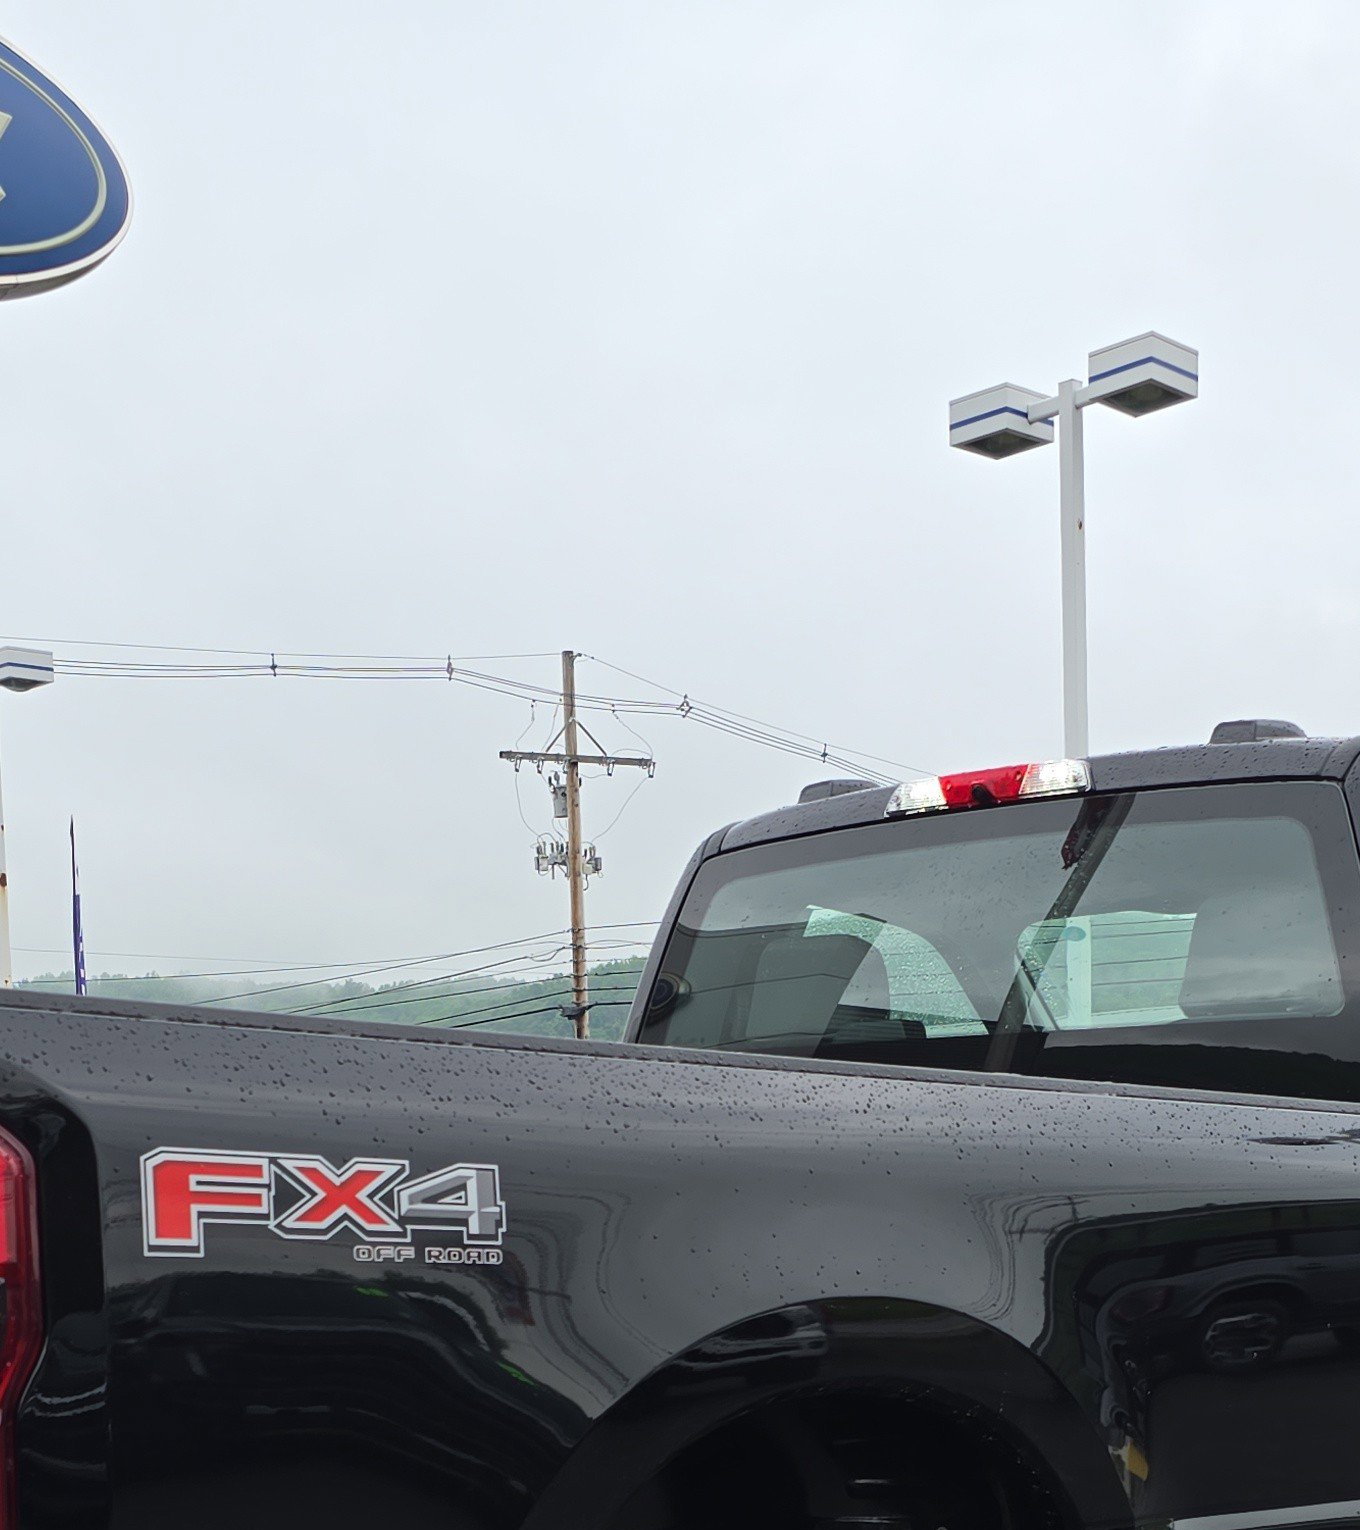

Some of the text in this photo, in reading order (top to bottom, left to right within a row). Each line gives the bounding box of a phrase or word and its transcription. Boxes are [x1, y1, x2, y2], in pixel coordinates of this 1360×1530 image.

[141, 1147, 506, 1257] FX4
[353, 1244, 503, 1265] OFF ROAD
